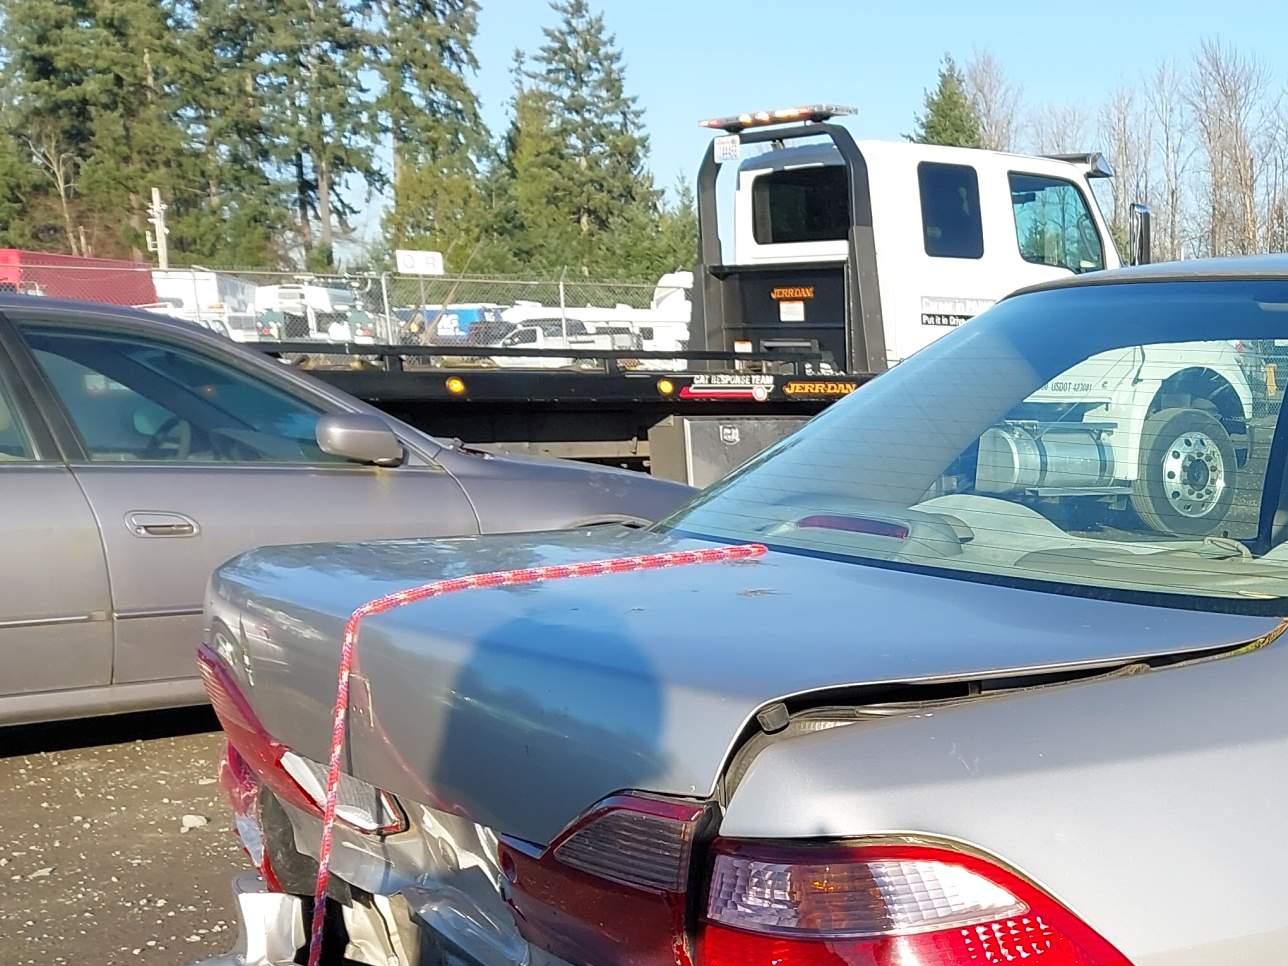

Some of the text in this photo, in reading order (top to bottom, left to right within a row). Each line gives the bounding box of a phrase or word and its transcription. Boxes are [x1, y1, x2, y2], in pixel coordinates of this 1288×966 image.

[711, 375, 751, 384] RESPONSE
[751, 375, 774, 384] TEAM
[1051, 382, 1072, 392] USDOT
